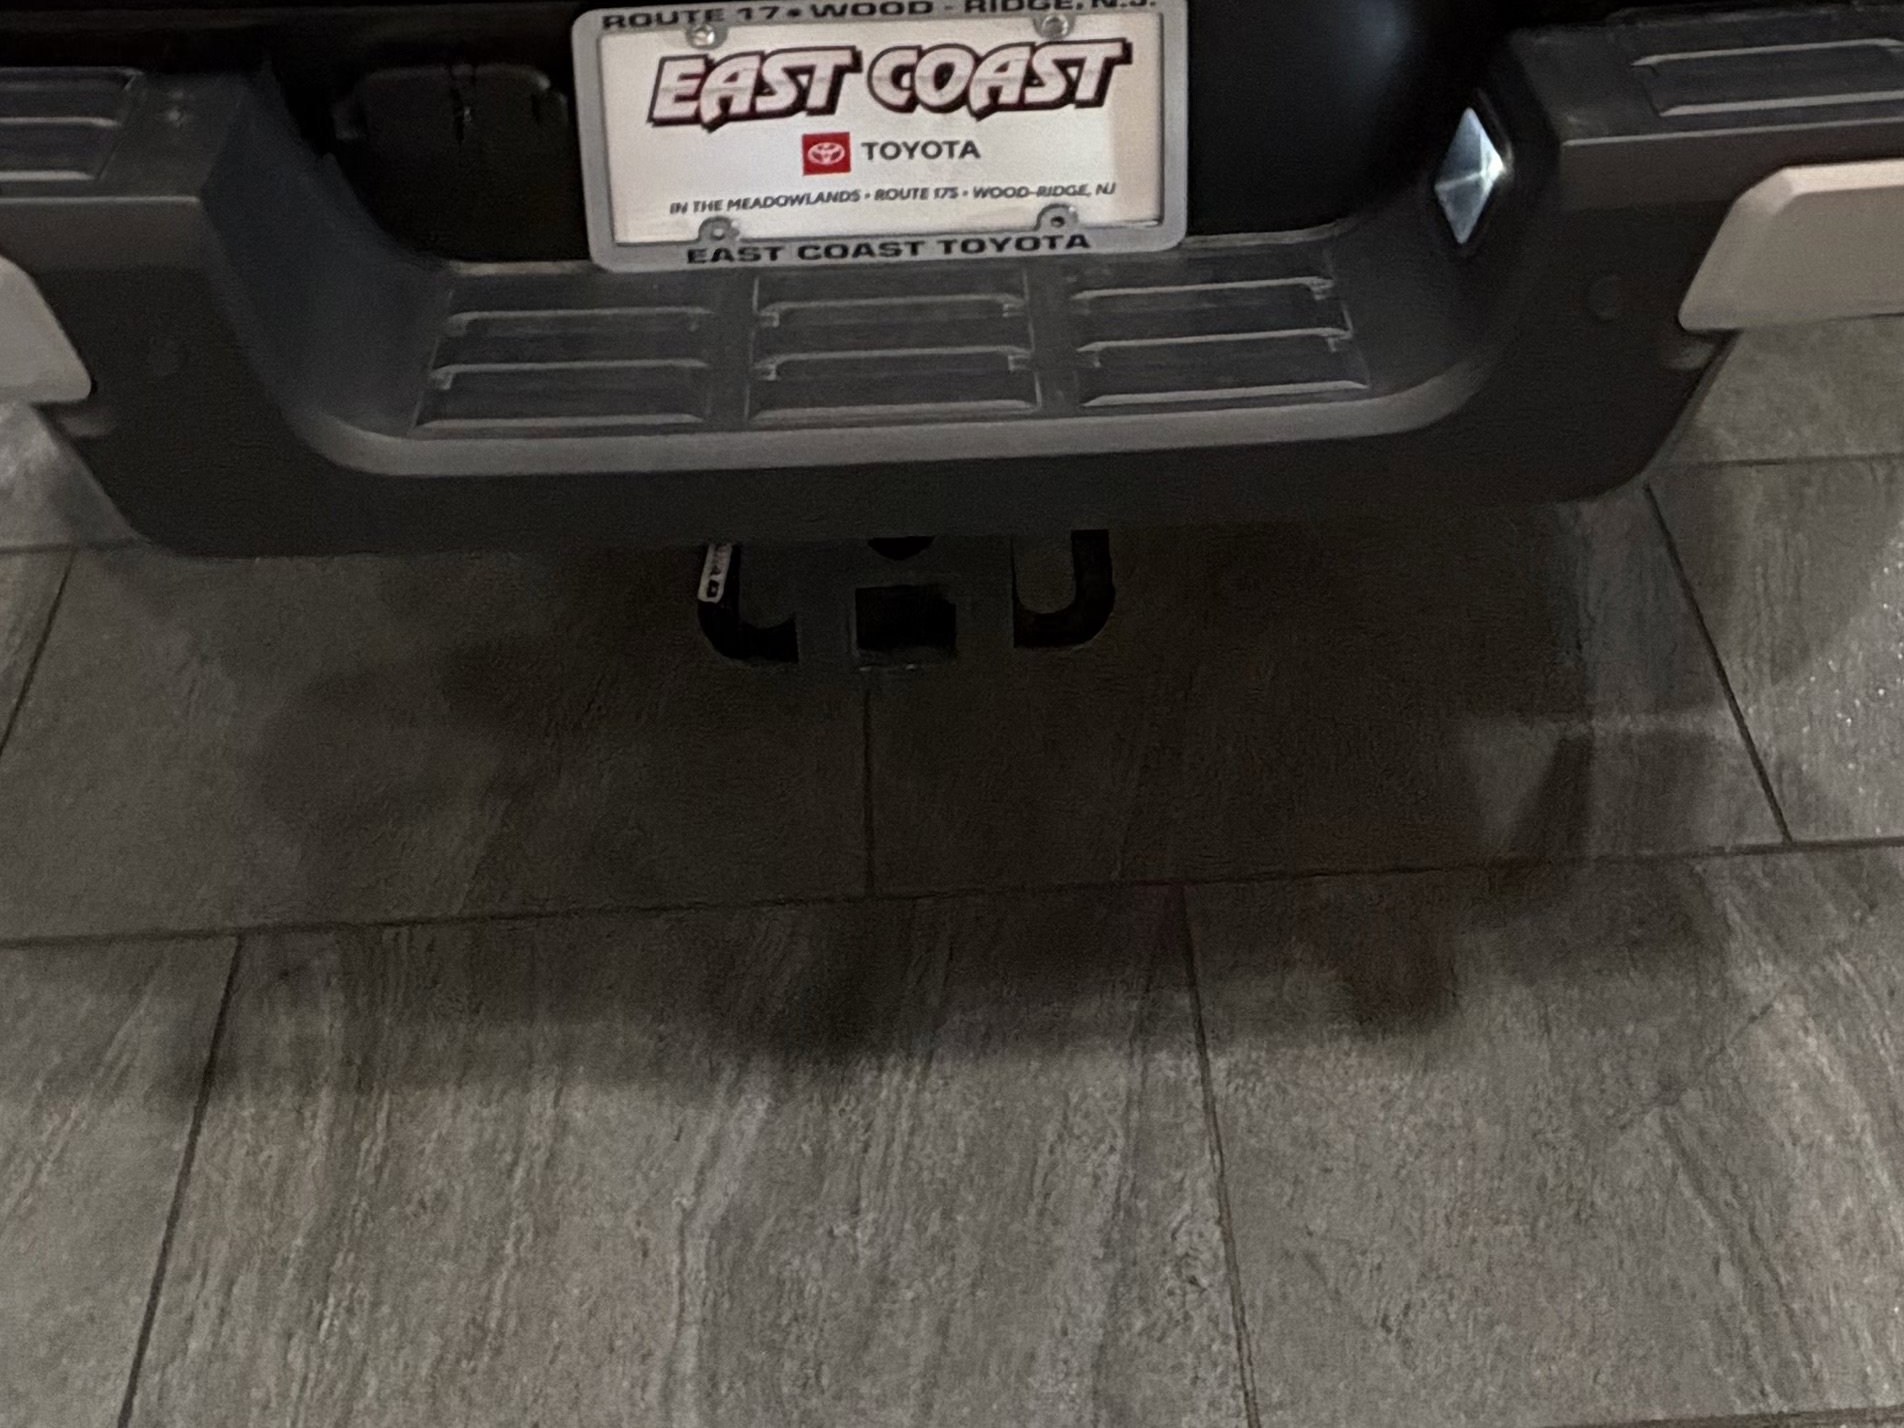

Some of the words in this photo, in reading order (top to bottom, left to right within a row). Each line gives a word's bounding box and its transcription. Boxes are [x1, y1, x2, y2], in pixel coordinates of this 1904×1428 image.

[601, 8, 726, 30] ROUTE
[737, 5, 782, 21] 17
[809, 0, 934, 19] WOOD
[647, 46, 863, 132] EAST
[867, 37, 1134, 122] COAST
[860, 139, 982, 163] TOYOTA
[669, 201, 689, 215] IN
[692, 198, 723, 214] THE
[726, 189, 861, 212] MEADOWLANDS
[873, 186, 930, 202] ROUTE
[686, 245, 786, 265] EAST
[797, 240, 926, 262] COAST
[936, 233, 1092, 255] TOYOTA
